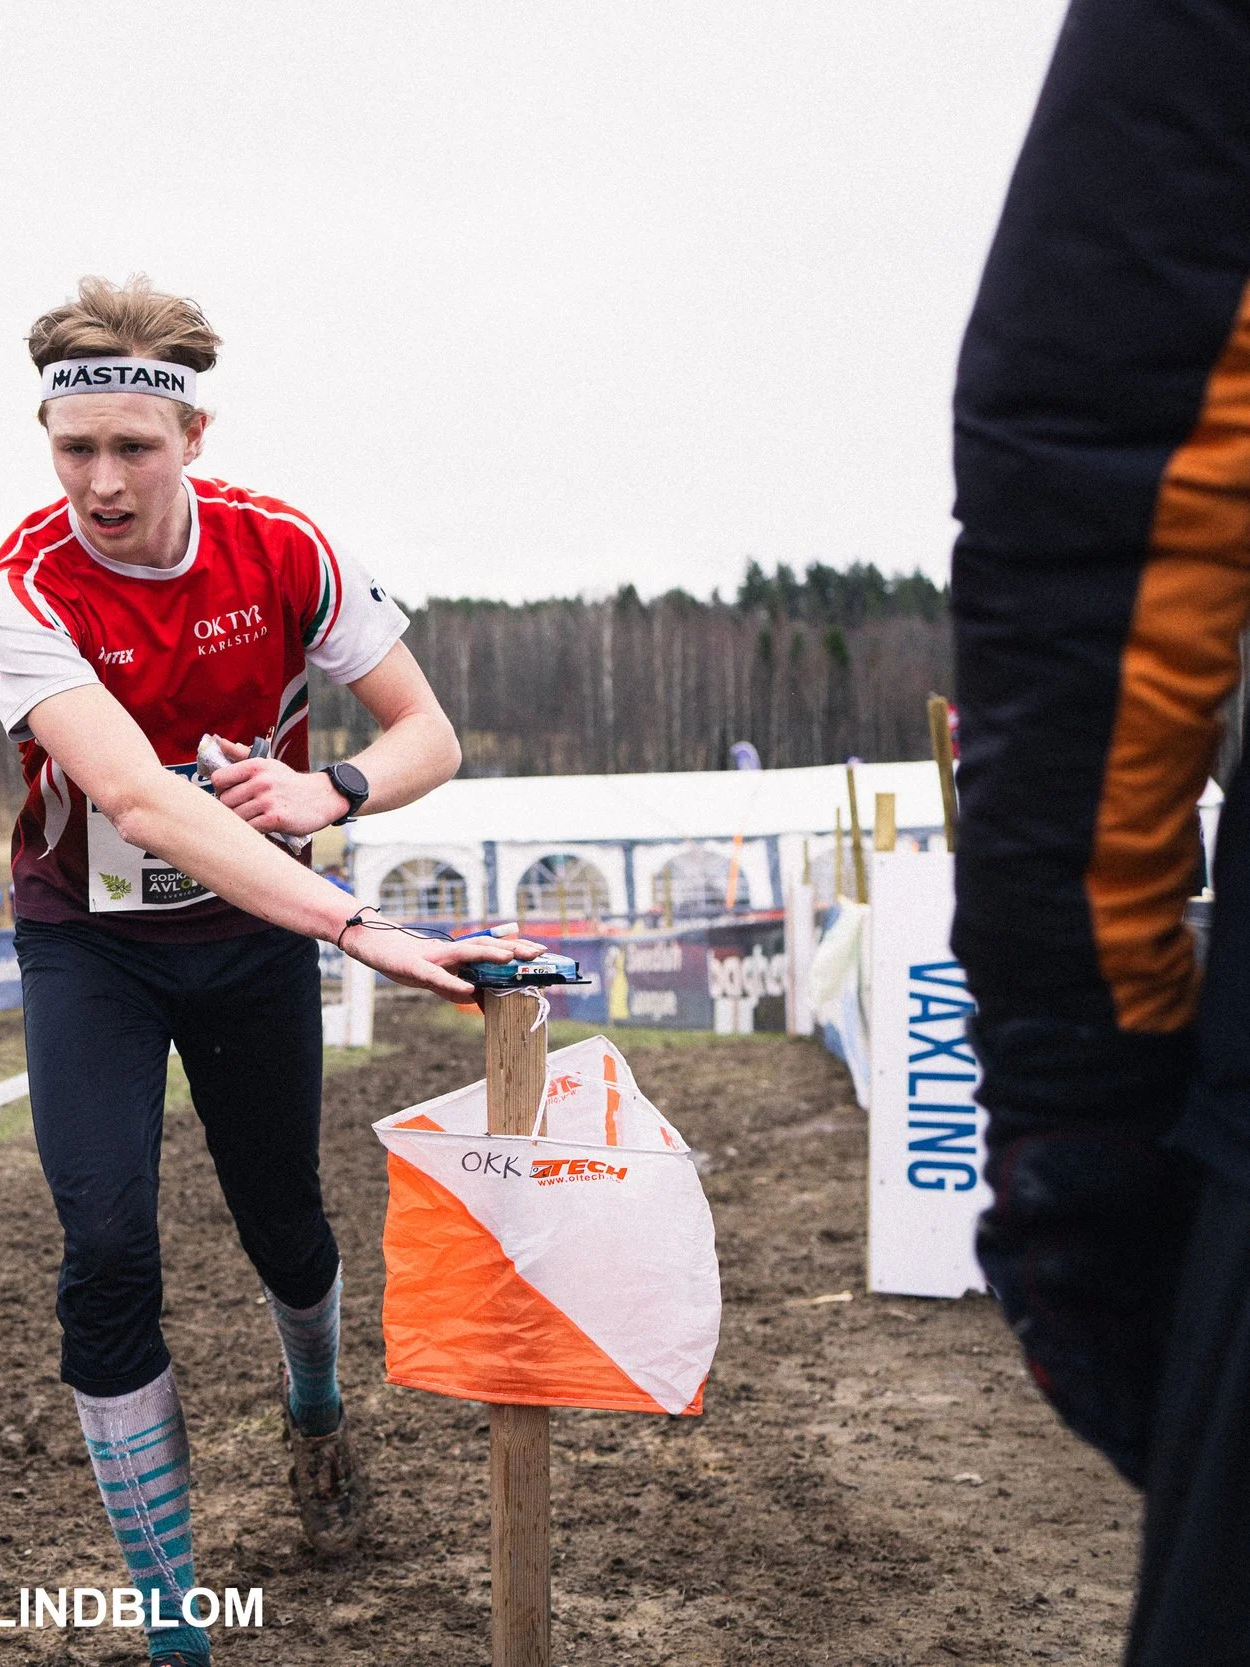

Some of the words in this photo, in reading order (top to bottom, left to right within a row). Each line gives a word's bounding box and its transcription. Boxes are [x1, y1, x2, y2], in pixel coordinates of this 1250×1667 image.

[52, 365, 185, 394] MÄSTARN
[193, 616, 227, 639] OK
[225, 604, 263, 630] TYR
[197, 625, 268, 656] KARLSTAD
[149, 871, 188, 882] GODK
[461, 1151, 523, 1179] OKK
